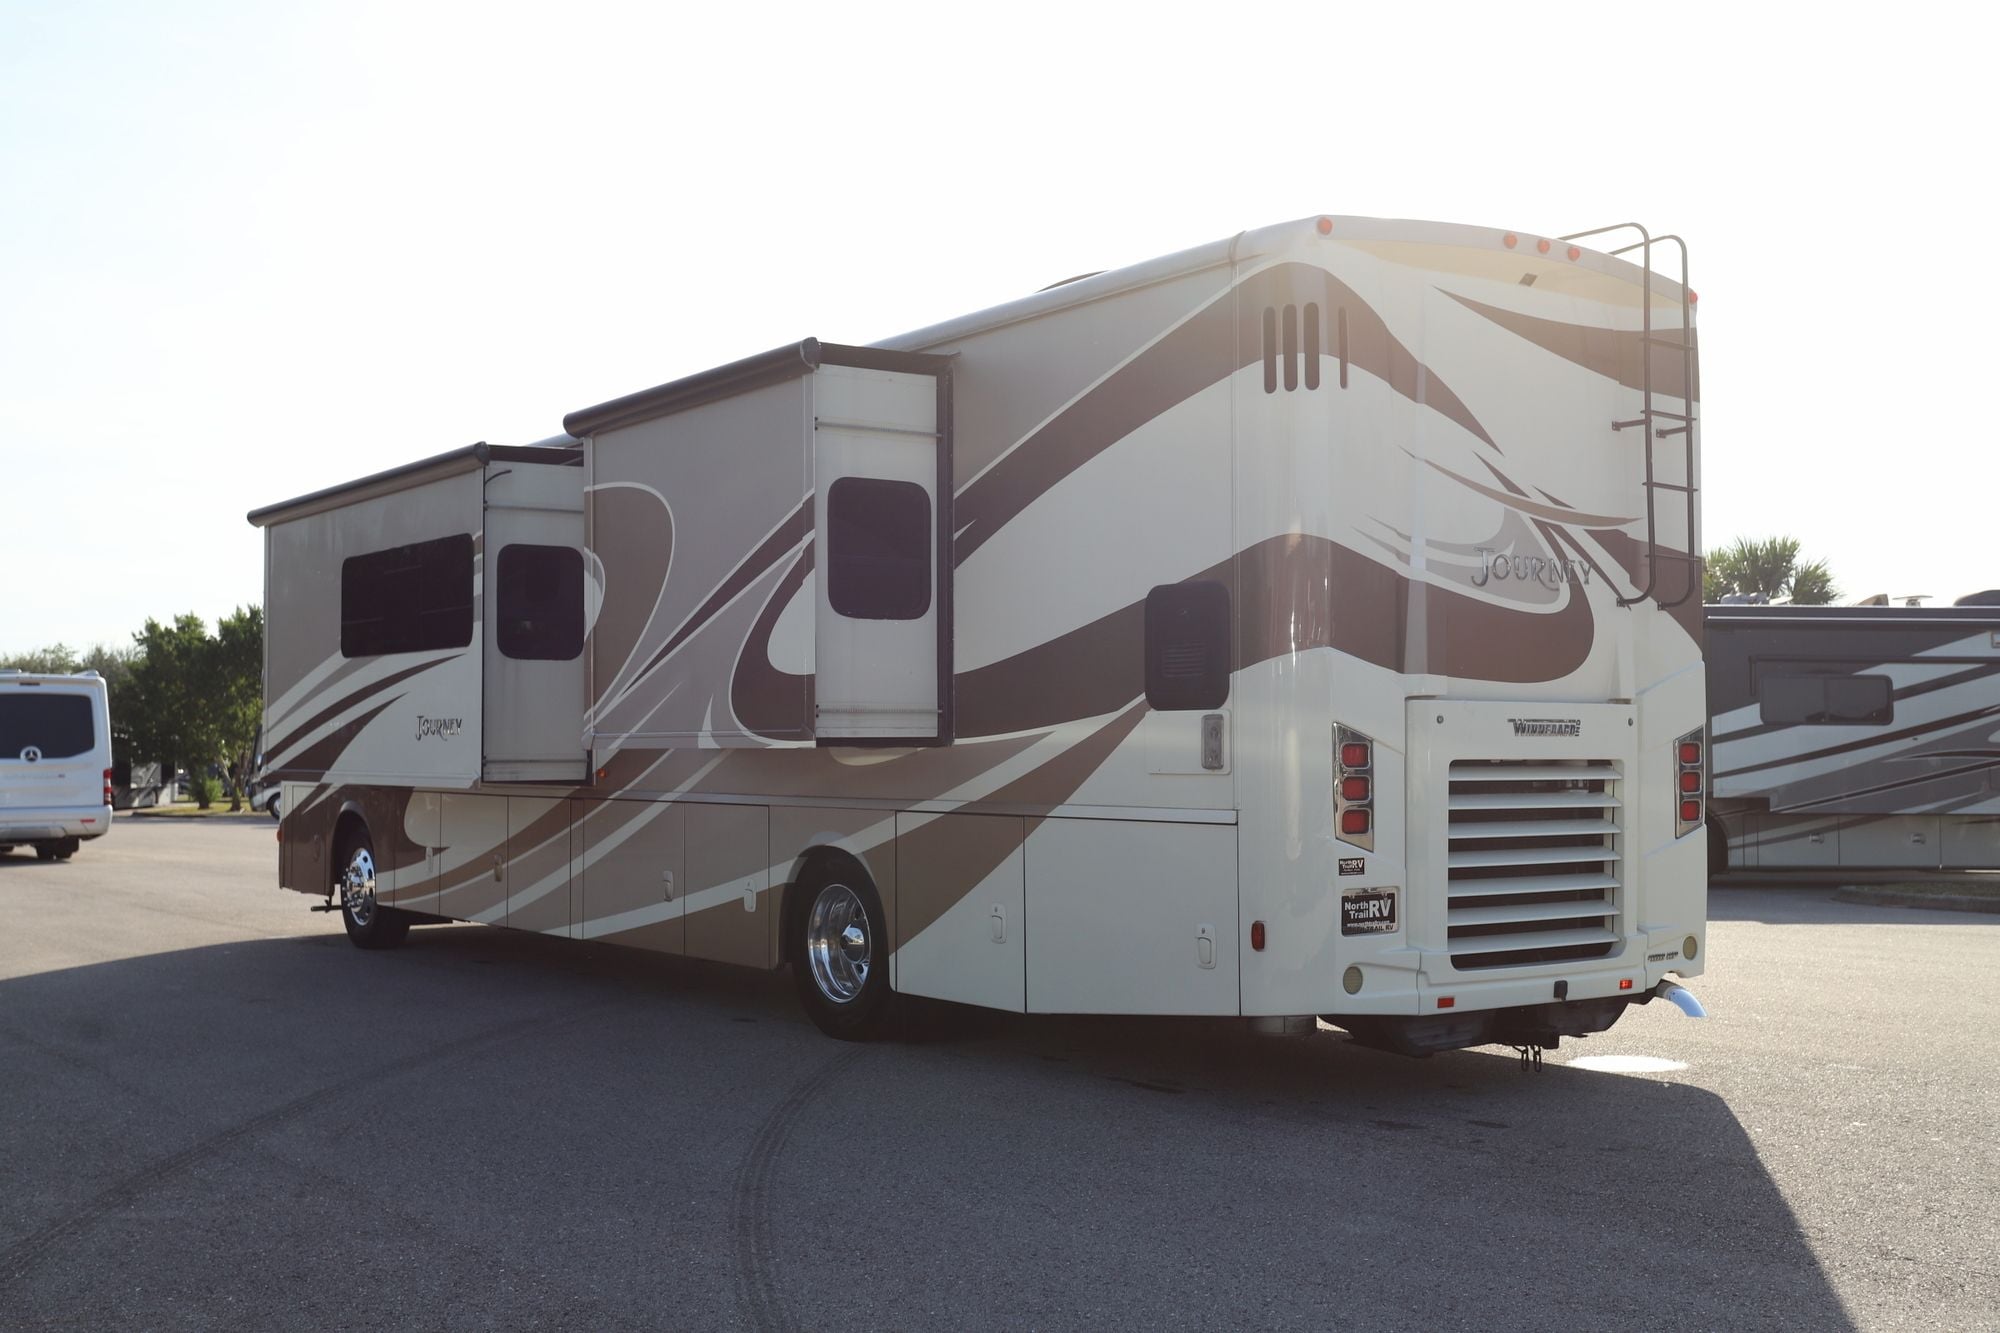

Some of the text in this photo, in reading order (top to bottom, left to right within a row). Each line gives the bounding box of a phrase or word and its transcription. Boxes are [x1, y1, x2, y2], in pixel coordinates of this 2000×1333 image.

[1471, 547, 1592, 592] JOURNEY
[416, 715, 462, 741] JOURNEY
[1352, 859, 1364, 868] RV
[1344, 902, 1368, 910] North
[1369, 900, 1391, 918] RV
[1349, 910, 1369, 919] Trail
